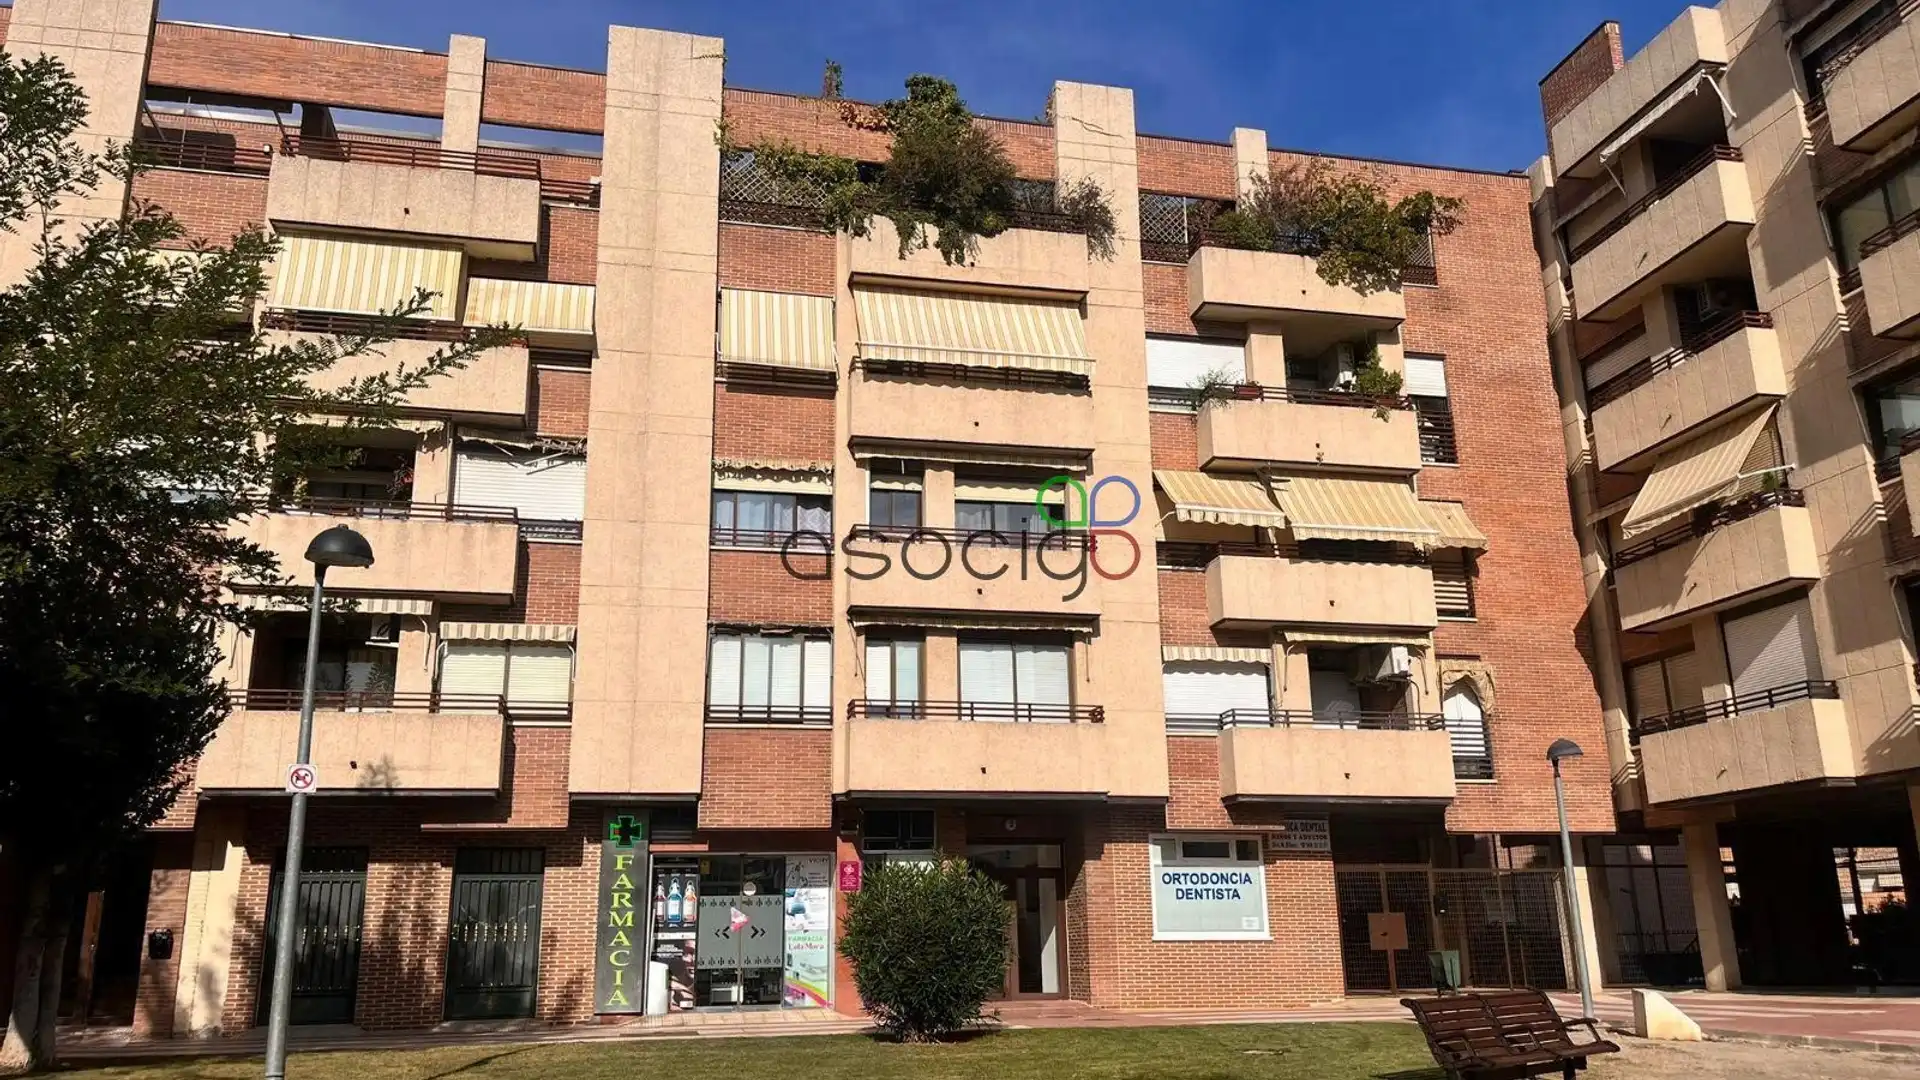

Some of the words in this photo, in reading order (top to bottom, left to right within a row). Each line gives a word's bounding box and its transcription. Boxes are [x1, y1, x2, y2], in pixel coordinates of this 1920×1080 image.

[1161, 872, 1253, 885] ORTODONCIA
[1175, 888, 1241, 900] DENTISTA
[604, 854, 635, 1006] FARMACIA
